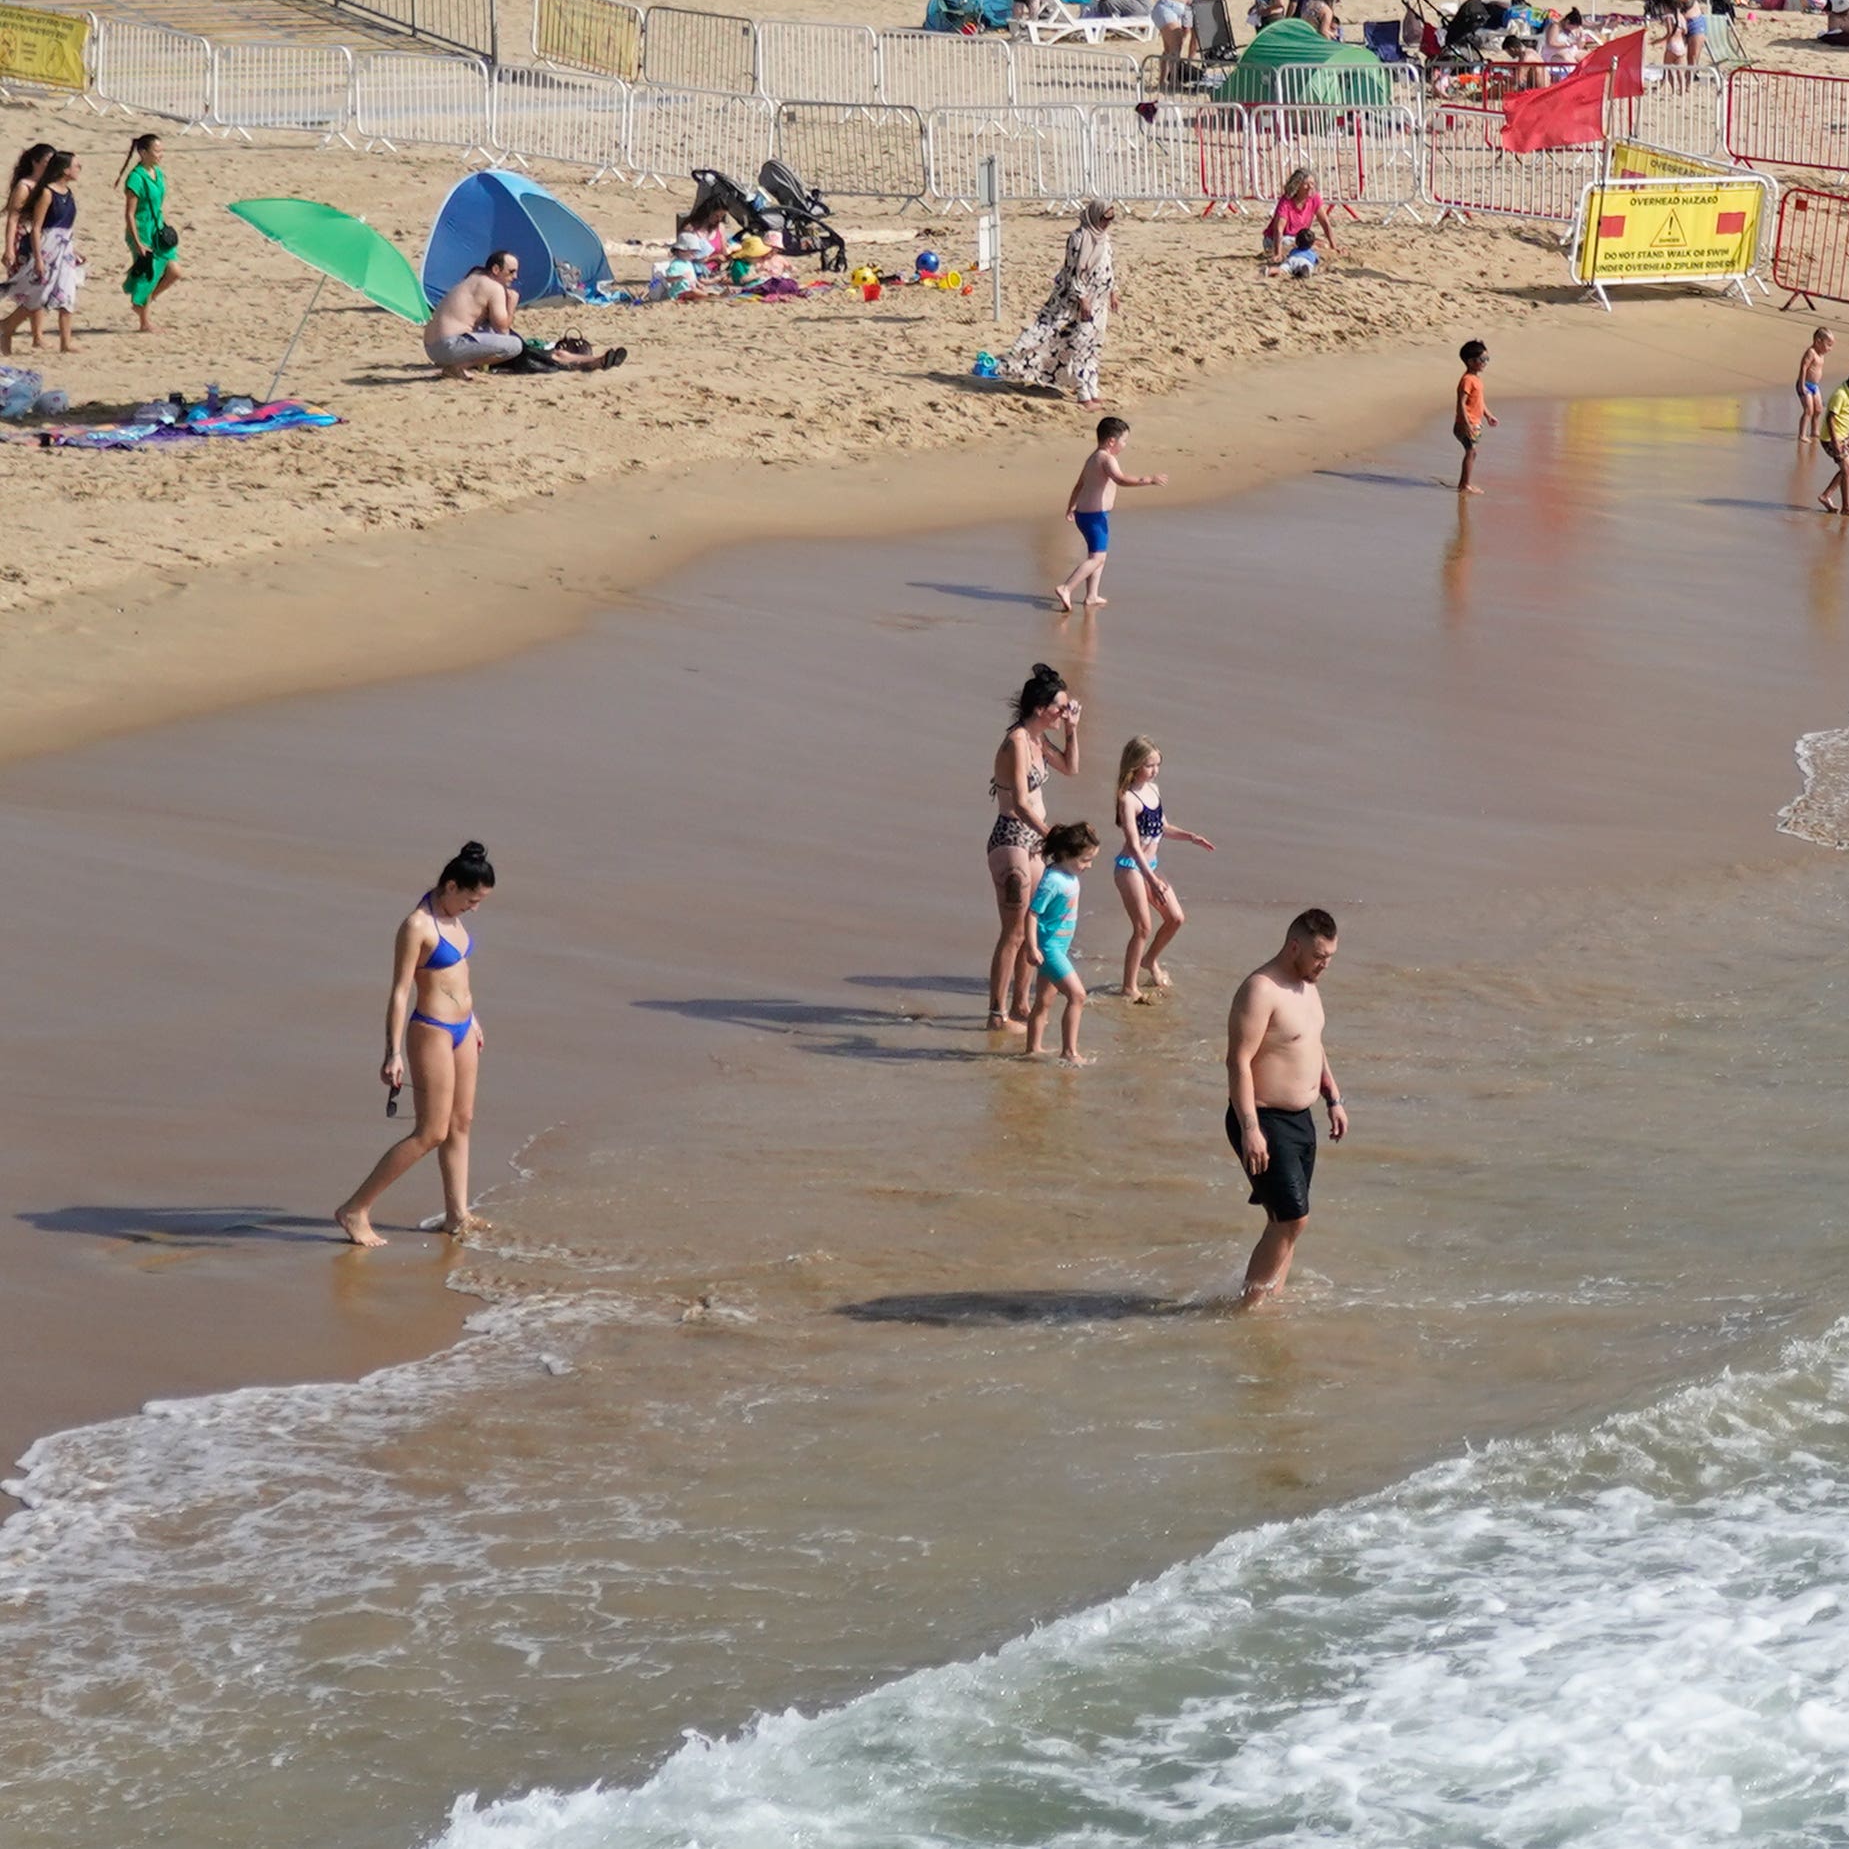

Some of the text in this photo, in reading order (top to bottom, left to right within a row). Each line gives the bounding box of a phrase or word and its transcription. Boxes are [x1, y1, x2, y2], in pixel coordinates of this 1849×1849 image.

[1650, 158, 1696, 177] OVERHEAD
[1630, 195, 1719, 207] OVERHEAD HAZARD
[1604, 251, 1617, 260] DO
[1619, 251, 1635, 260] NOT
[1667, 250, 1690, 258] WALK
[1693, 249, 1705, 258] OR
[1707, 248, 1730, 257] SWIM
[1595, 260, 1737, 273] UNDER OVERHEAD ZIPLINE RIDERS
